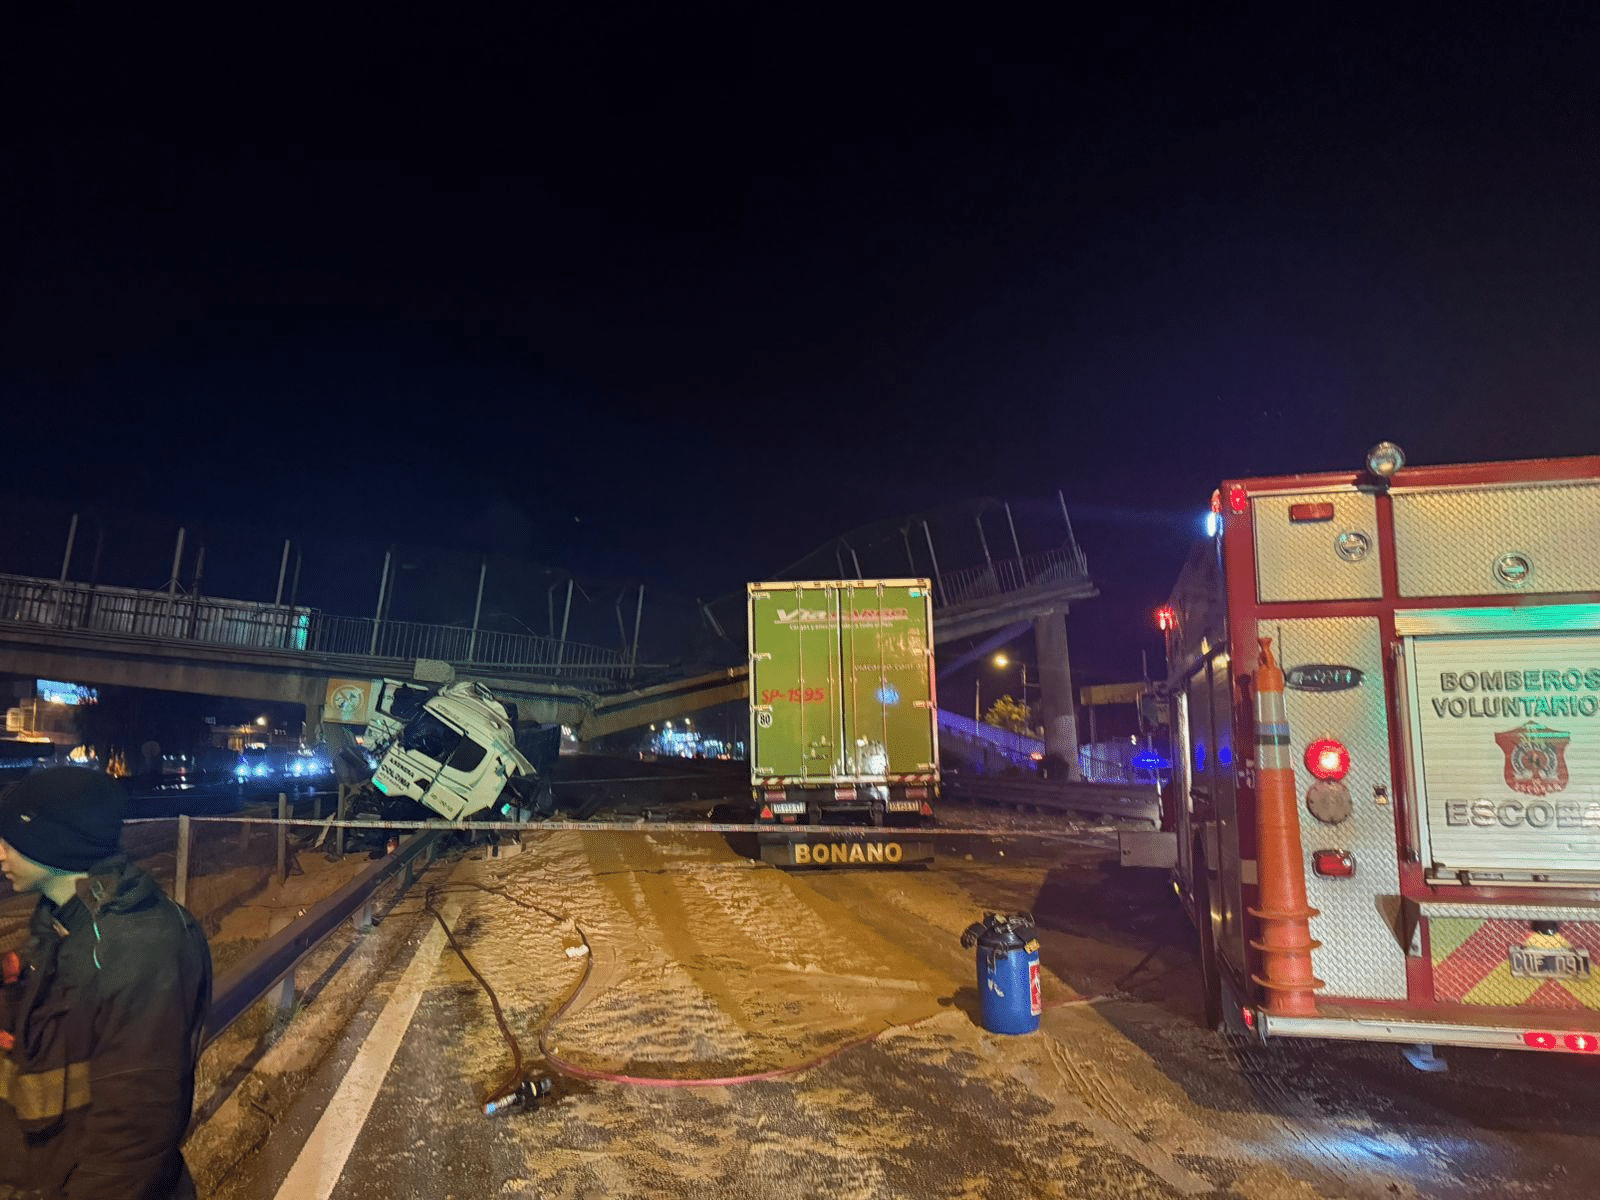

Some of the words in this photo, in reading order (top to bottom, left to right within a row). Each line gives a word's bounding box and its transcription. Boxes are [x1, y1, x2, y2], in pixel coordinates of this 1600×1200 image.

[1441, 668, 1600, 692] BOMBEROS
[759, 712, 771, 726] 80
[794, 842, 902, 864] BONANO
